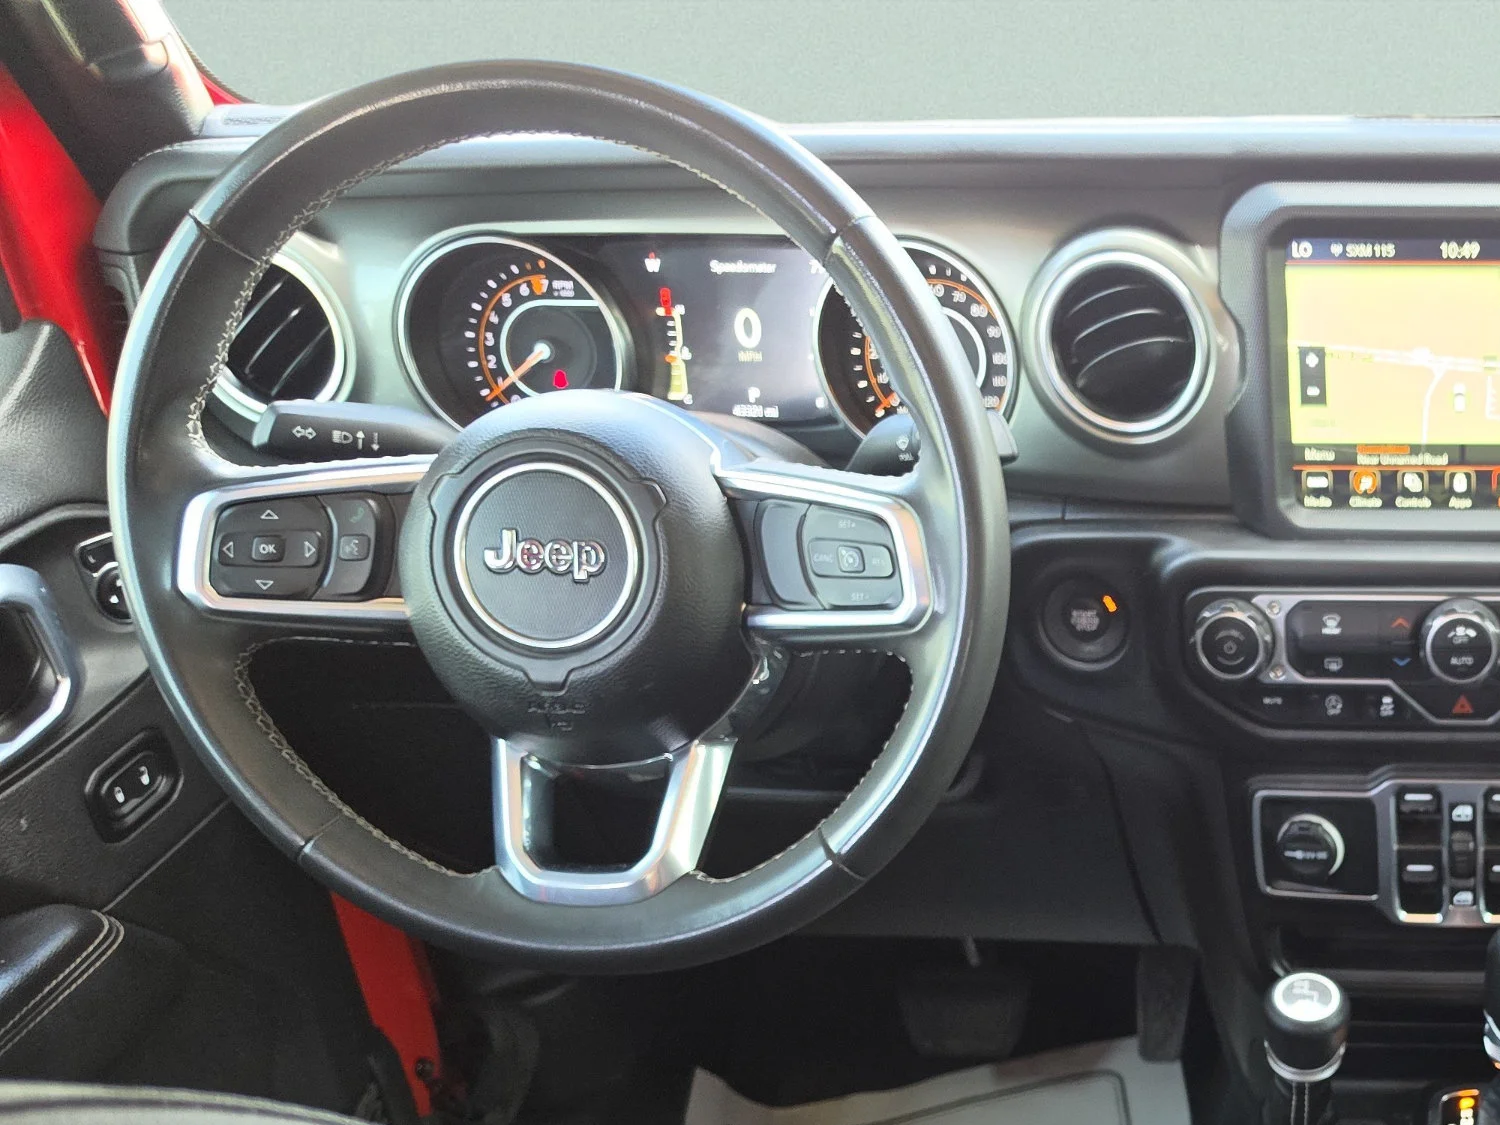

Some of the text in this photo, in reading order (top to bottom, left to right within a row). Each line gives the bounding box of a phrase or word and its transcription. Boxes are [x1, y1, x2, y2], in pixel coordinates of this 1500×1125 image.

[1292, 240, 1313, 258] LO
[1345, 243, 1395, 258] SXM 115
[1440, 241, 1480, 259] 10:49
[519, 282, 530, 297] 6
[501, 292, 513, 308] 5
[489, 310, 499, 324] 4
[734, 307, 762, 349] 0
[484, 331, 495, 347] 3
[487, 354, 497, 369] 2
[259, 543, 277, 555] OK
[484, 528, 607, 583] Jeep
[1450, 656, 1475, 666] AUTO
